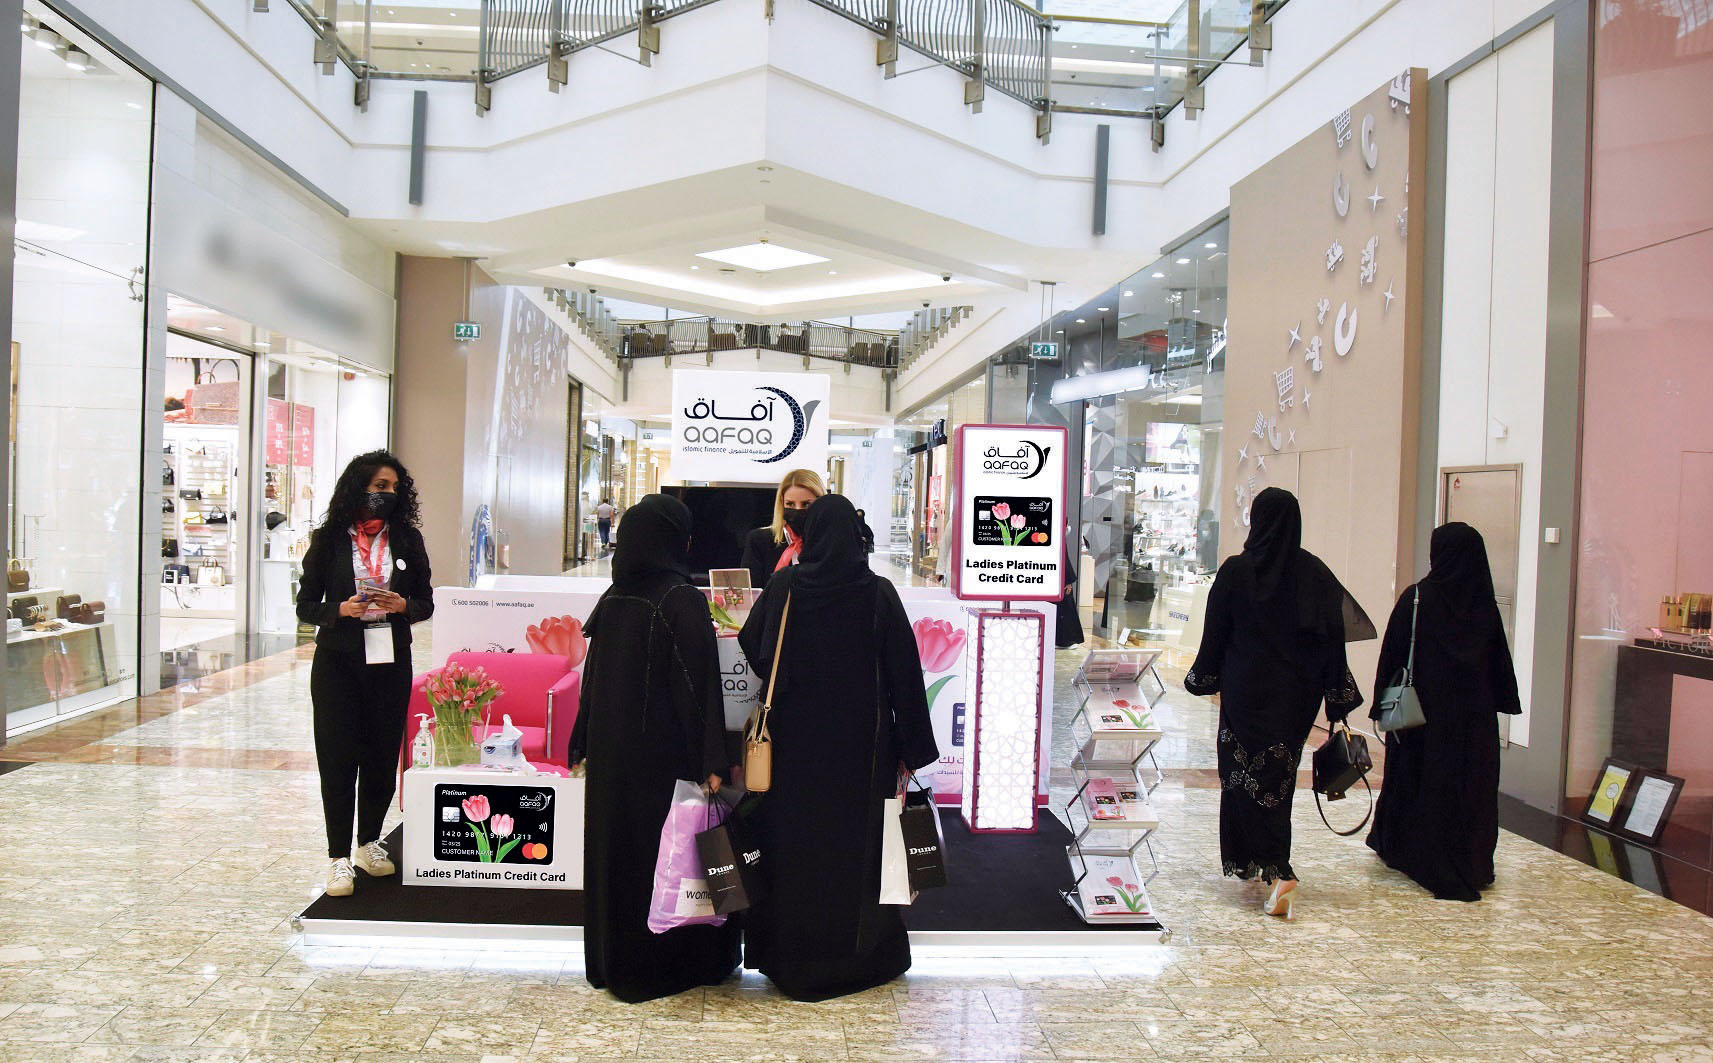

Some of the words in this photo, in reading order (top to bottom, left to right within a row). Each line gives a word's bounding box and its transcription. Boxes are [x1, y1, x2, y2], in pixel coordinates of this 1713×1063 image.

[966, 559, 1003, 569] Ladies
[1006, 560, 1057, 570] Platinum
[979, 573, 1014, 583] Credit
[1016, 574, 1044, 584] Card
[909, 846, 936, 855] Dune
[743, 849, 761, 864] Dune
[416, 868, 451, 878] Ladies
[454, 870, 501, 880] Platinum
[504, 871, 537, 881] Credit
[540, 872, 566, 882] Card
[708, 864, 734, 876] Dune
